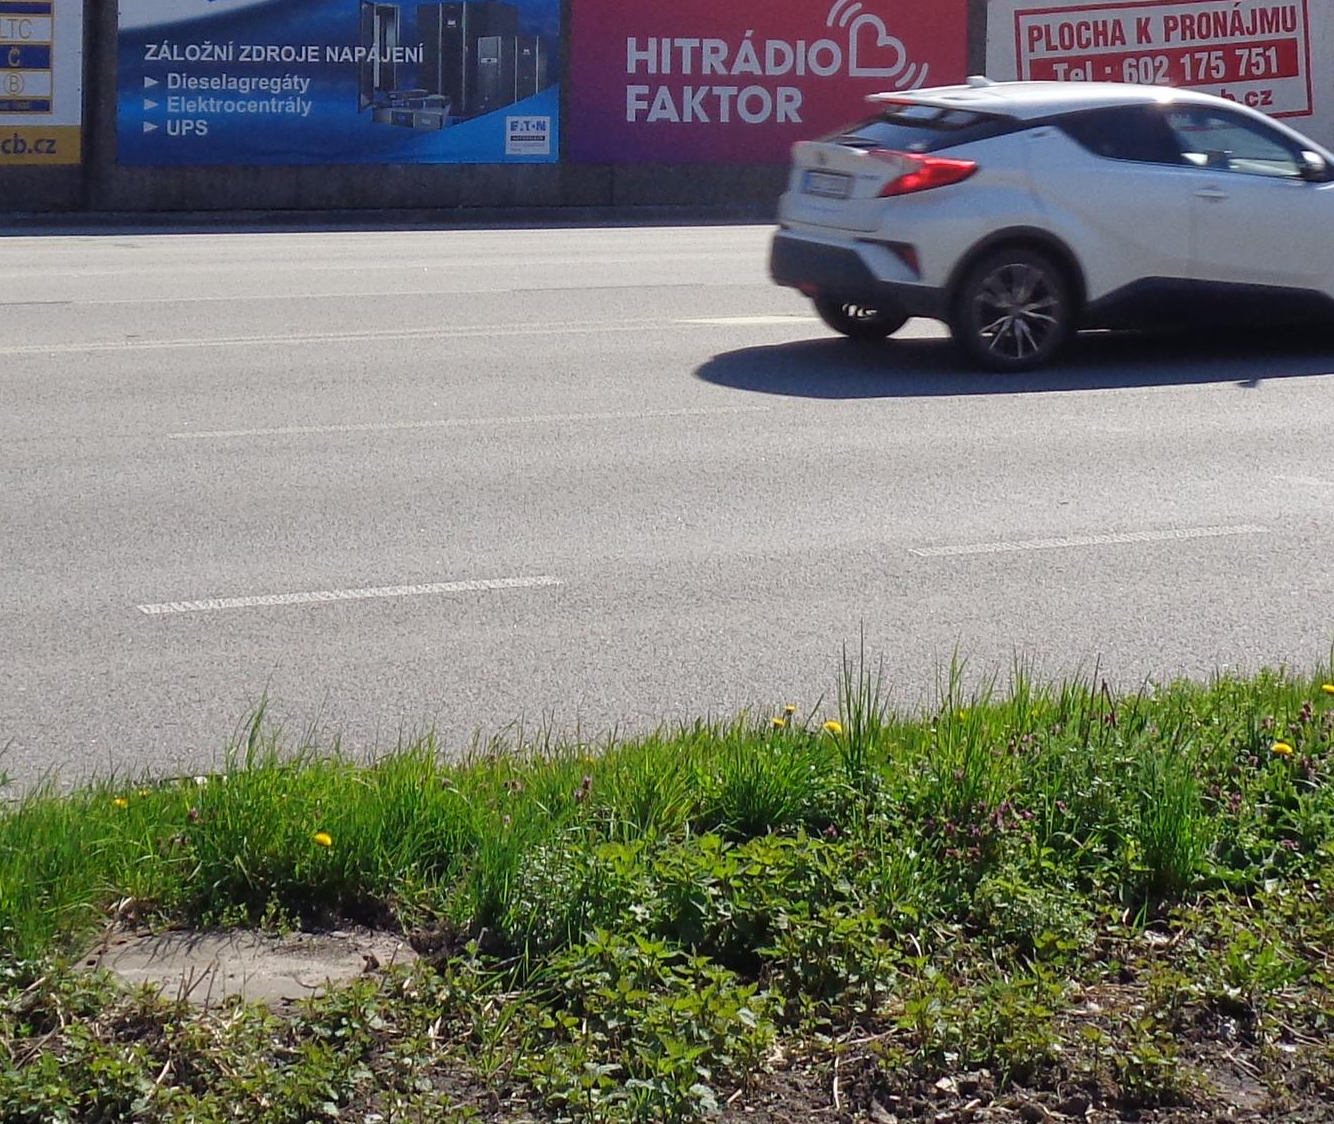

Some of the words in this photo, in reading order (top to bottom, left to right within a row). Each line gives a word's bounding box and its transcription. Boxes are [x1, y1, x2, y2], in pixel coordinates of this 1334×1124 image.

[1027, 19, 1126, 53] PLOCHA
[1136, 17, 1152, 44] K
[1163, 2, 1297, 43] PRONÁJMU
[145, 40, 233, 61] ZÁLOŽNÍ
[238, 45, 320, 63] ZDROJE
[326, 42, 424, 64] NAPÁJENÍ
[625, 29, 842, 77] HITRÁDIO
[1123, 55, 1170, 84] 602
[1180, 51, 1226, 80] 175
[1235, 46, 1278, 75] 751
[168, 73, 310, 94] Dieselagregáty
[168, 95, 312, 117] Elektrocentrály
[625, 84, 802, 124] FAKTOR
[167, 120, 208, 137] UPS
